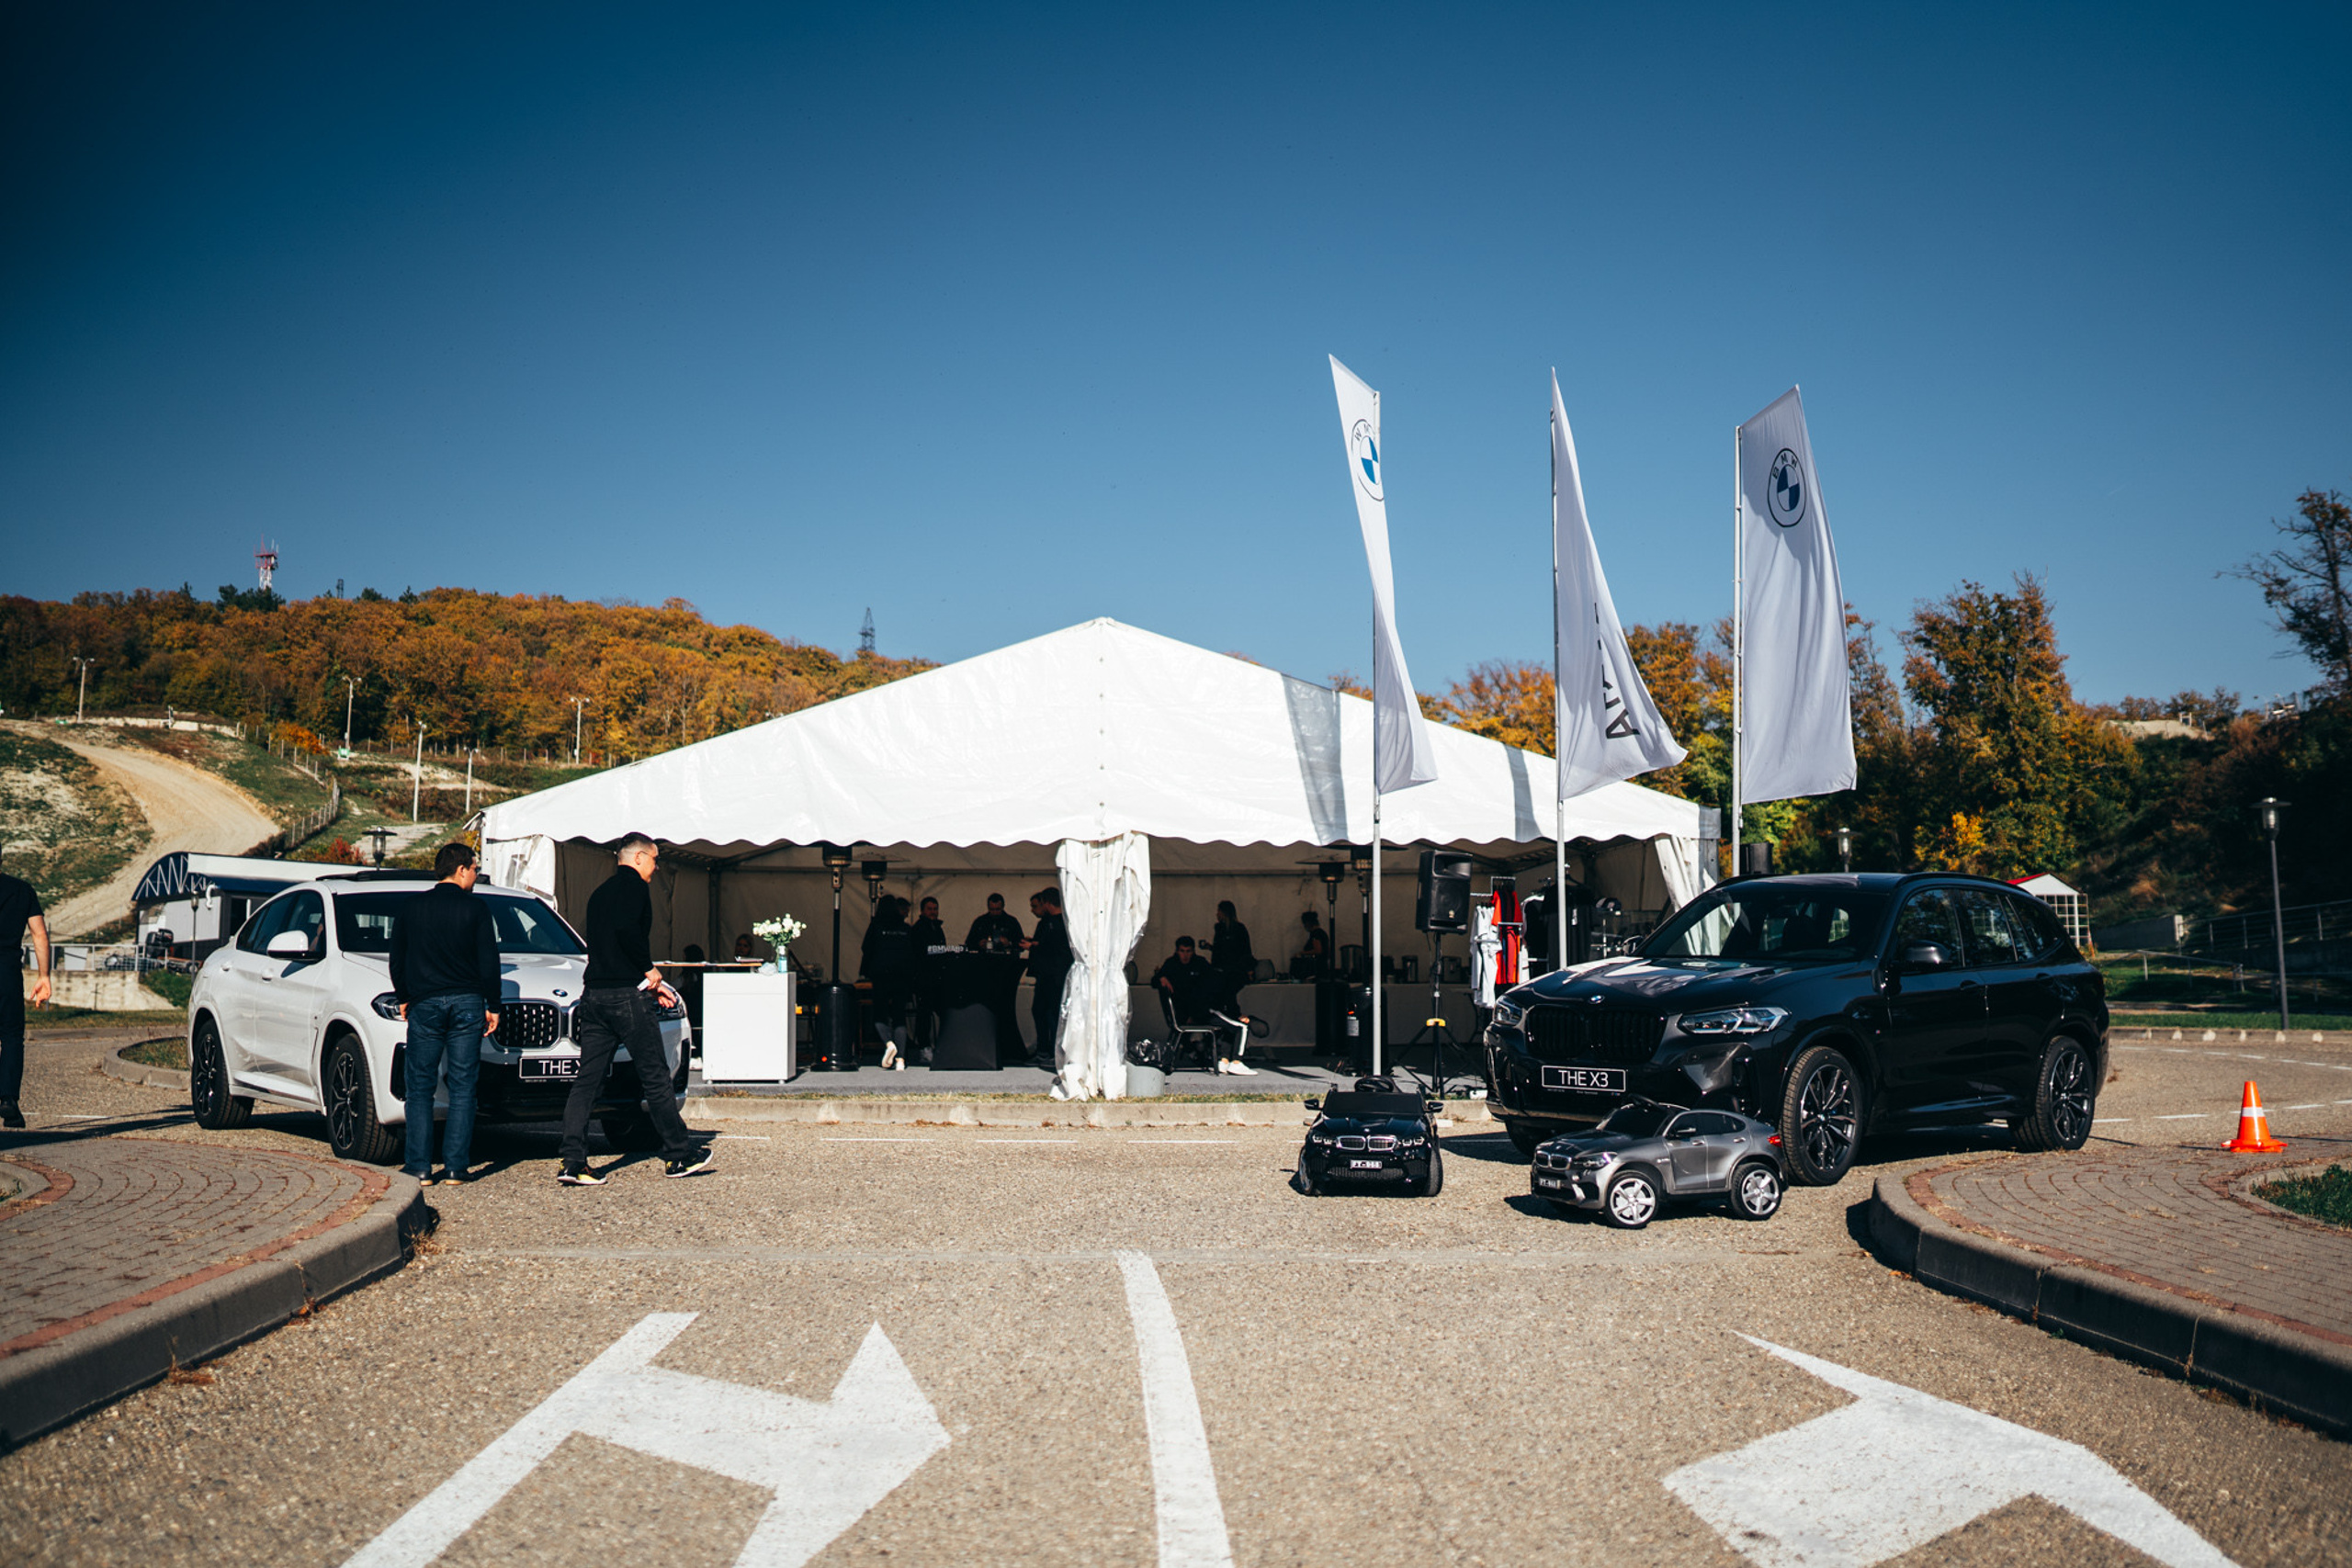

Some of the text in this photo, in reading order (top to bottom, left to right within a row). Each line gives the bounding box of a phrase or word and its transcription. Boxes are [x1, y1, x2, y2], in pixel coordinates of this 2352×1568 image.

[1772, 452, 1798, 479] BMW
[538, 1060, 571, 1075] THE
[1558, 1069, 1609, 1088] THE X3
